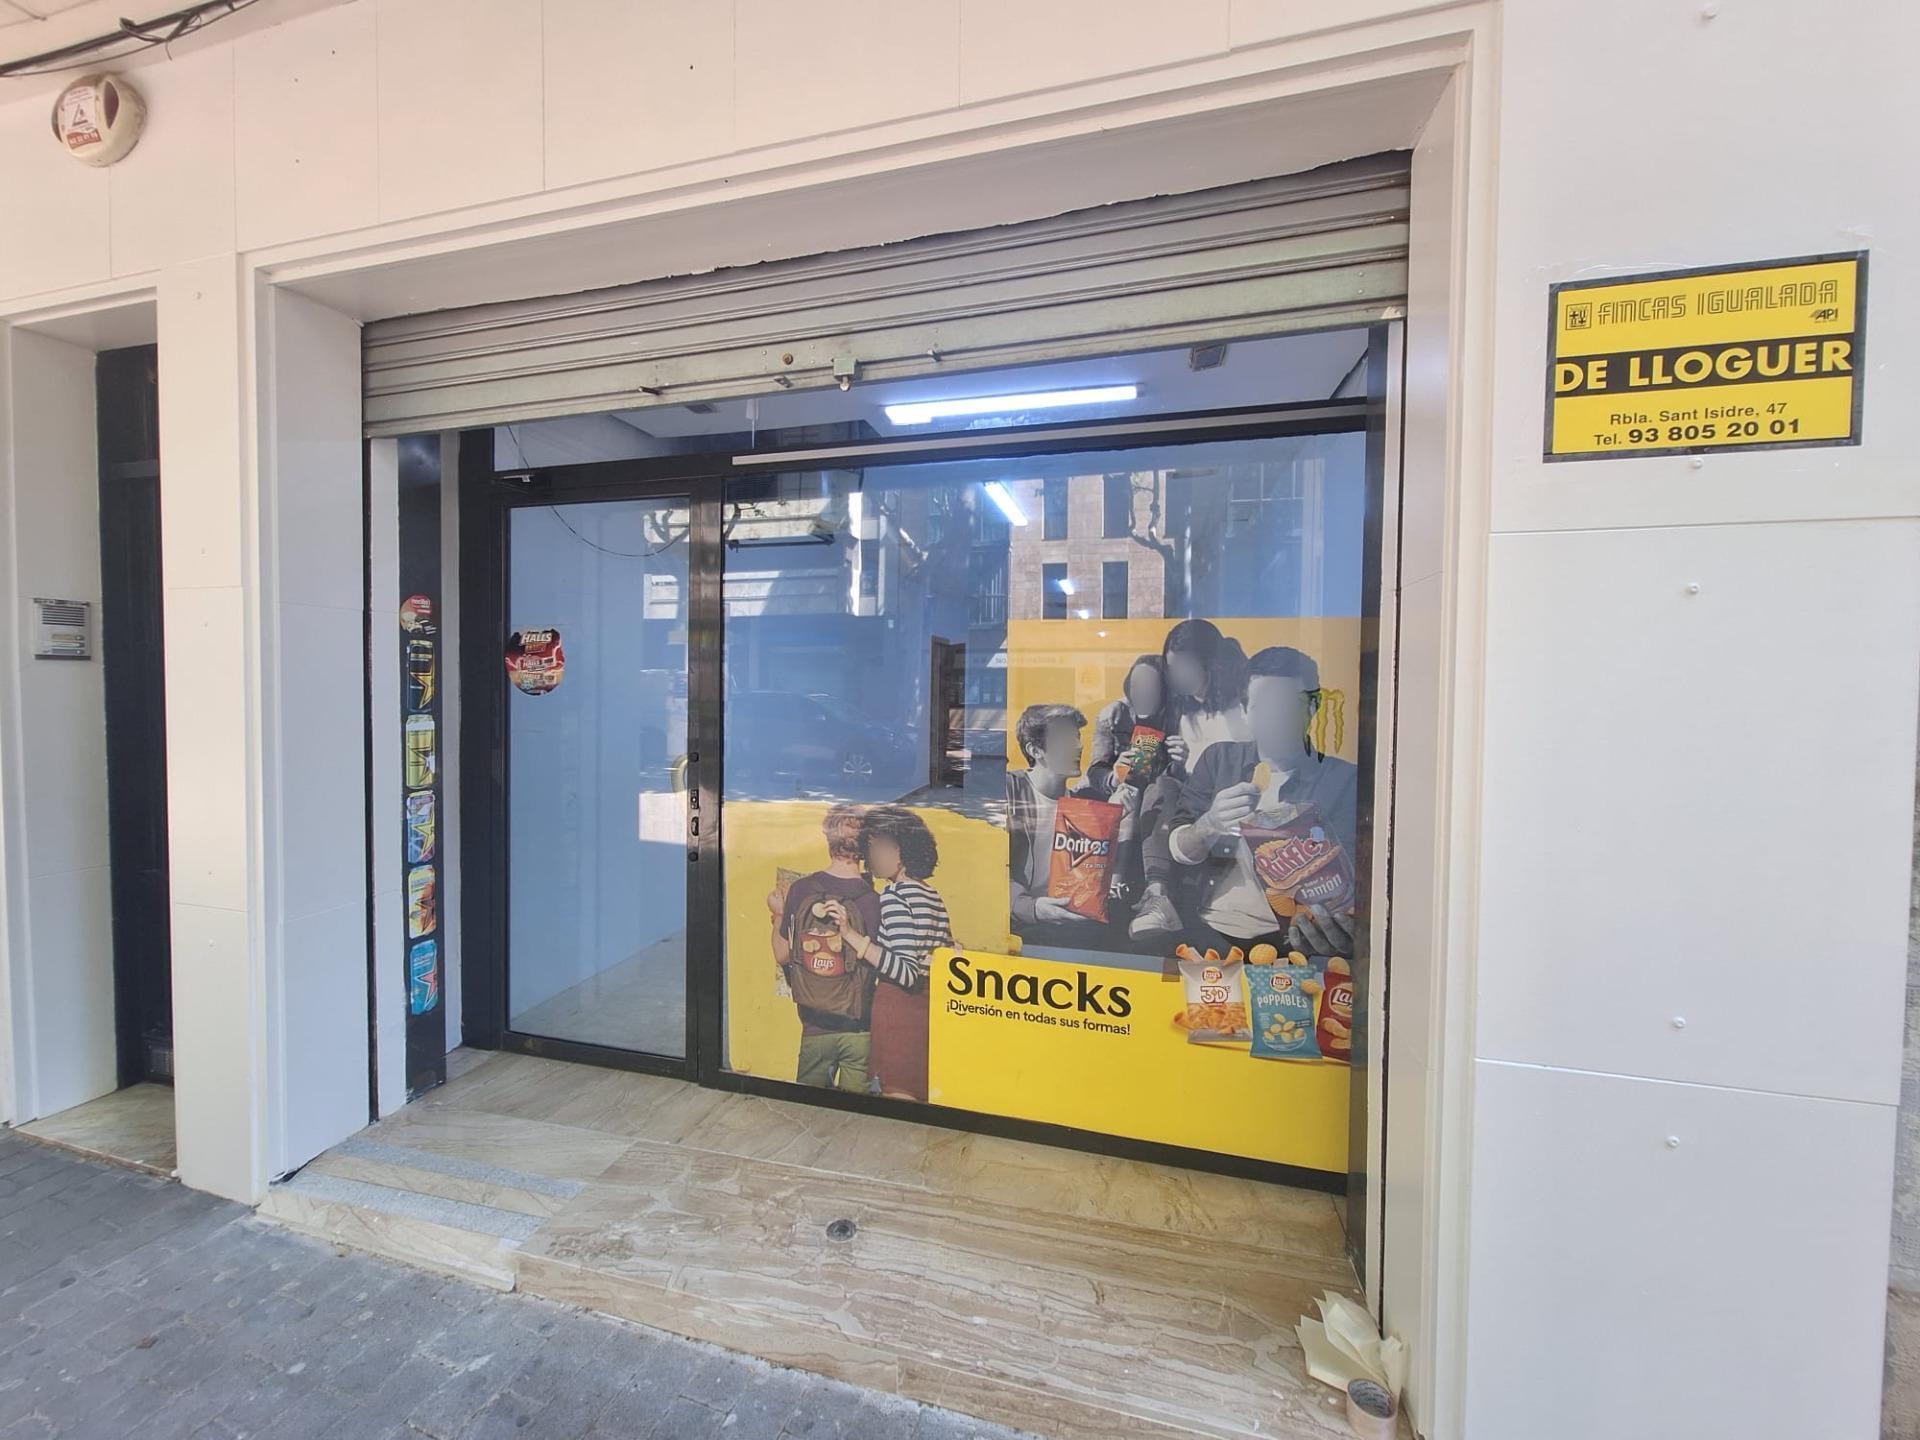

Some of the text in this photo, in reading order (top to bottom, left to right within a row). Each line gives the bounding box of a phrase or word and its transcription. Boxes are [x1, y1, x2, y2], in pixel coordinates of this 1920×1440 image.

[1597, 280, 1838, 325] FINCAS IGUALADA
[1555, 340, 1853, 393] DE LLOGUER
[1610, 413, 1652, 426] Rbla.
[1659, 408, 1698, 422] Sant
[1766, 402, 1788, 415] 47
[1594, 418, 1800, 446] Tel. 93 805 20 01
[519, 632, 553, 647] HALLS
[1054, 832, 1110, 855] Doritos
[947, 956, 1132, 1018] Snacks
[1257, 994, 1308, 1009] POPPABLES
[946, 999, 1131, 1036] ¡Diversión en todas sus formas!
